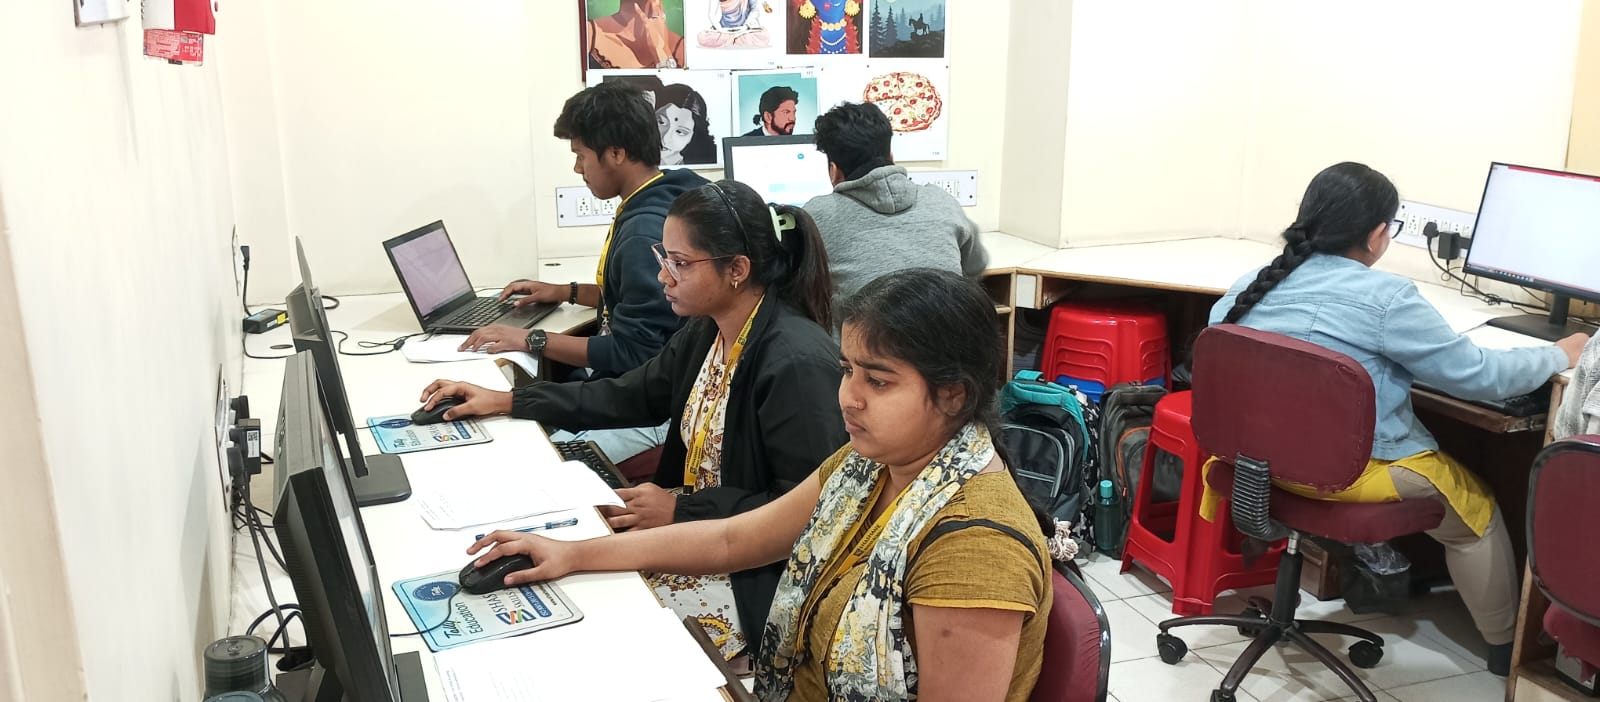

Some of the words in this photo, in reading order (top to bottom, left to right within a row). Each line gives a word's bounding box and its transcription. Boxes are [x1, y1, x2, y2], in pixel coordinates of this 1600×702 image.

[482, 593, 507, 613] SHAS
[455, 601, 483, 634] Education
[442, 619, 462, 639] Tally
